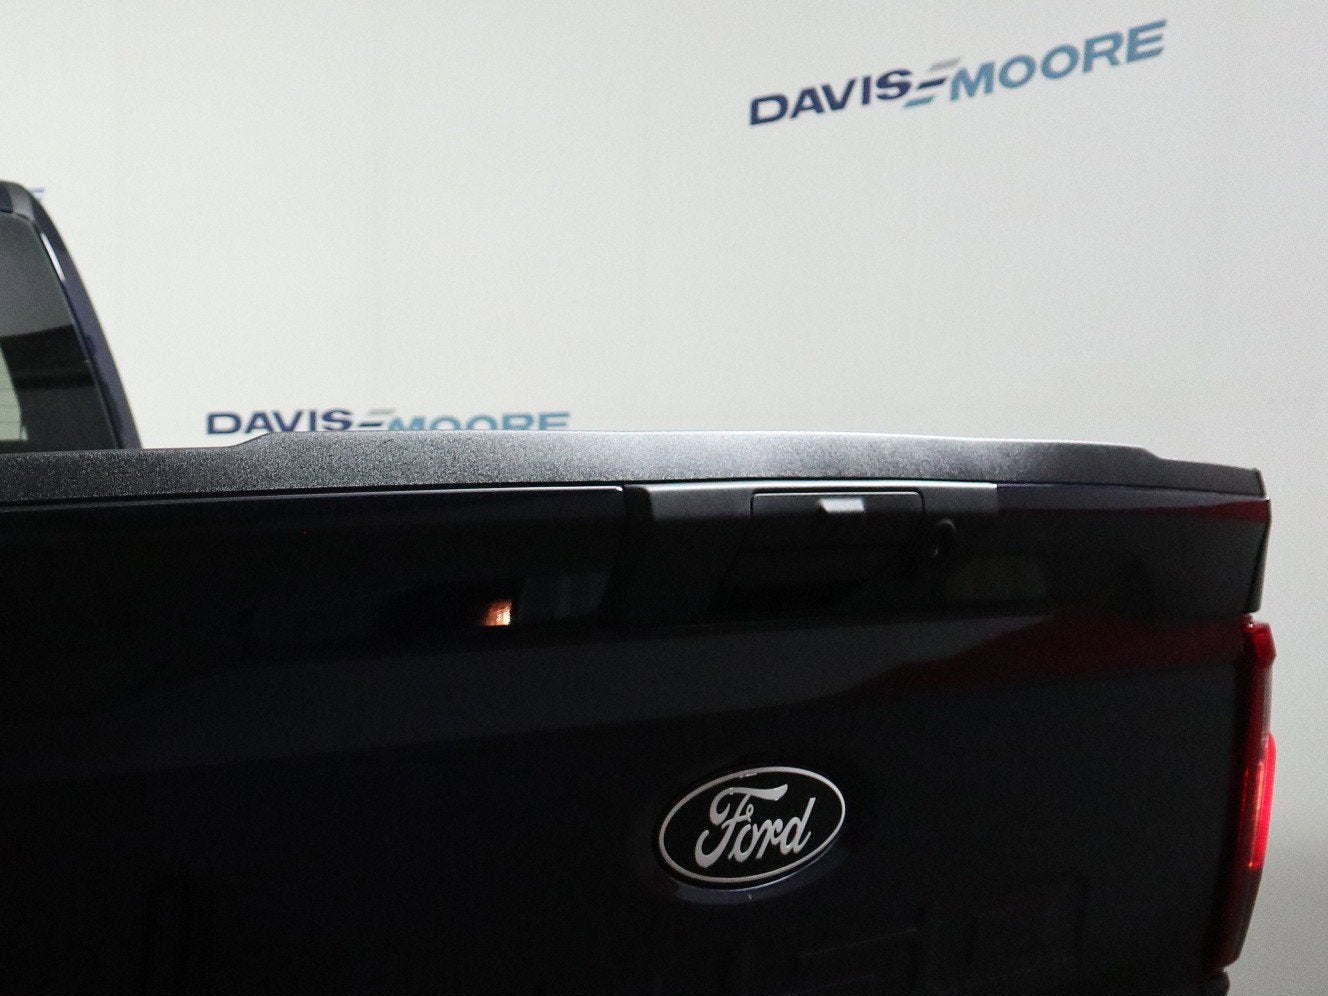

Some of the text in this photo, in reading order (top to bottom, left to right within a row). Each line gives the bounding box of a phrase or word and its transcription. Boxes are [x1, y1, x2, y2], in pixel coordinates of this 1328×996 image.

[749, 18, 1168, 126] DAVIS MOORE
[206, 408, 354, 435] DAVIS
[694, 783, 817, 869] Ford
